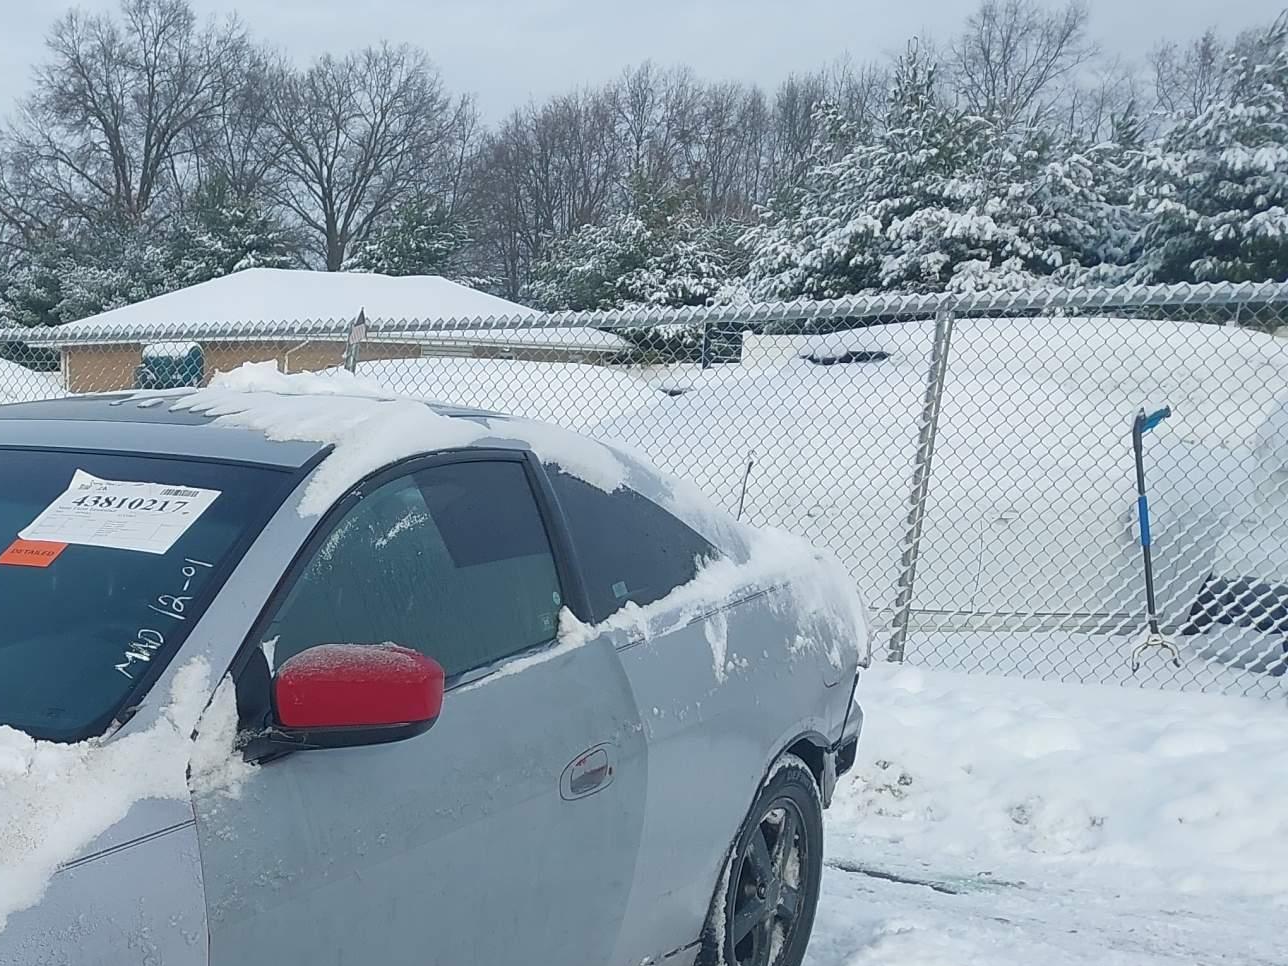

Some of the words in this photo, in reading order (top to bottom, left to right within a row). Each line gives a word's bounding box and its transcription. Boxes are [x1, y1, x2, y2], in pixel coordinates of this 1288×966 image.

[72, 494, 189, 514] 43810217
[9, 548, 55, 556] DETAILED
[147, 557, 214, 620] 12-01
